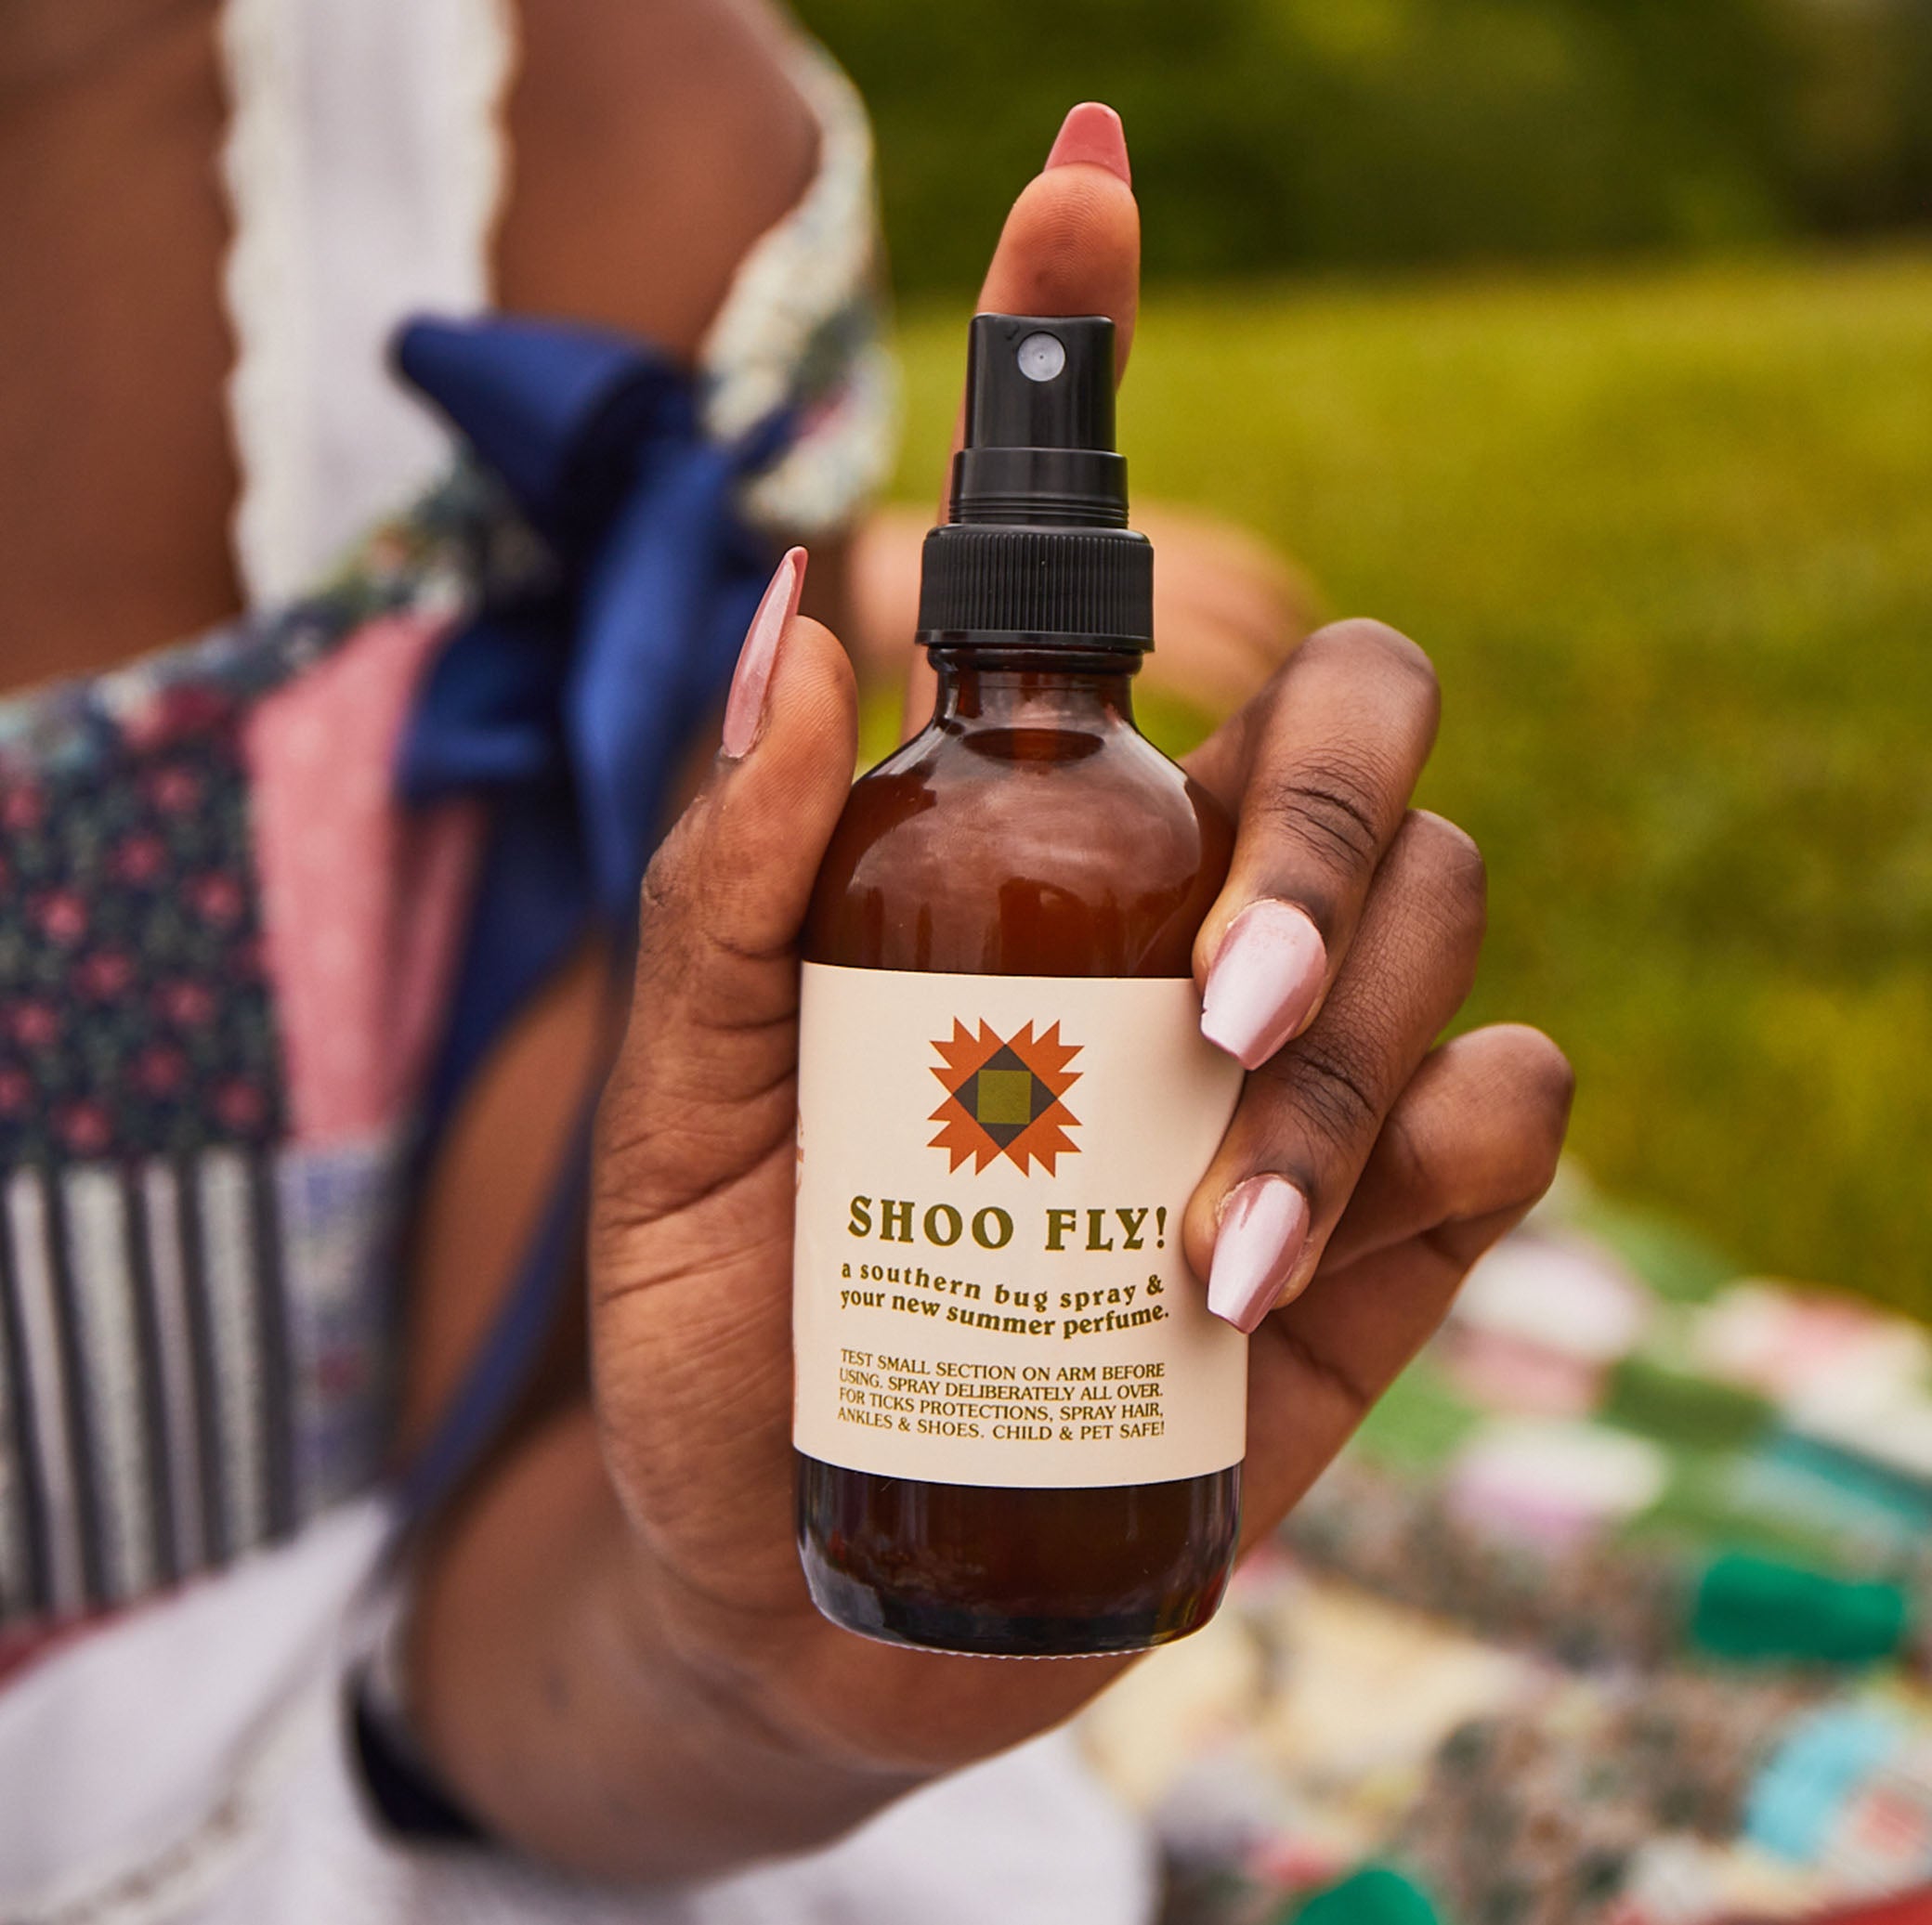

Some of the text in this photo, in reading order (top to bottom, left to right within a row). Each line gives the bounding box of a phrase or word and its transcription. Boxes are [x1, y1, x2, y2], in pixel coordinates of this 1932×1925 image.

[847, 1195, 1168, 1251] SHOO FLY!
[842, 1263, 1164, 1312] a southern bug spray &
[841, 1289, 1169, 1339] your new summer perfume.
[841, 1348, 1165, 1382] TEST SMALL SECTION ON ARM BEFORE
[840, 1368, 1163, 1401] USING. SPRAY DELIBERATELY ALL OVER.
[838, 1406, 1165, 1440] ANKLES & SHOES. CHILD & PET SAFE!
[840, 1387, 1163, 1423] FOR TICKS PROTECTIONS, SPRAY HAIR,
